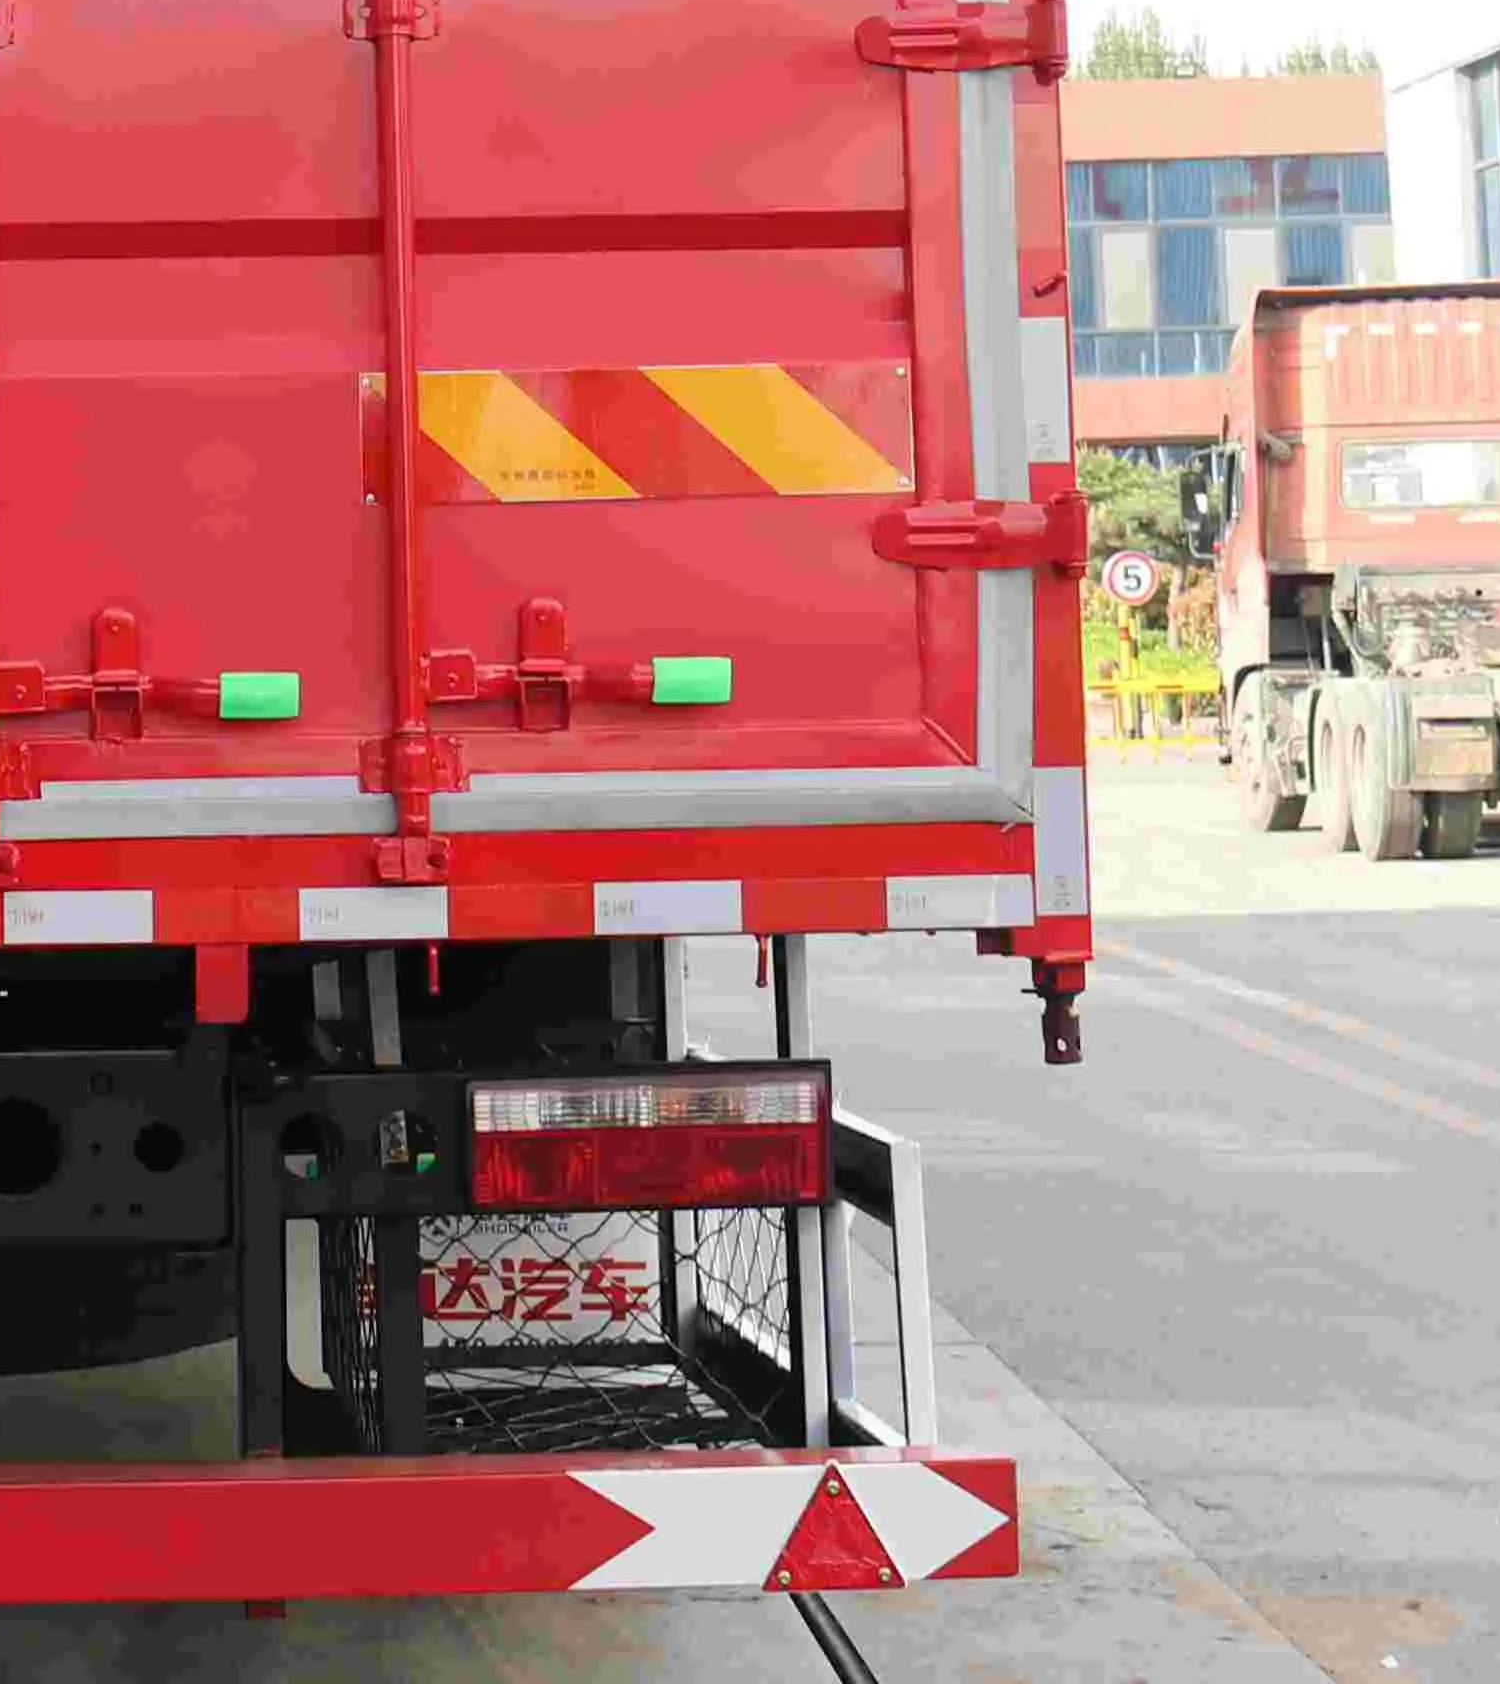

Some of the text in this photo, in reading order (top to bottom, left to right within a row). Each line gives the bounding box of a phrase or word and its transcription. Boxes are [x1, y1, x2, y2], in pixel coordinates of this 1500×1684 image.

[1124, 565, 1141, 591] 5
[357, 1258, 649, 1321] 达汽车
